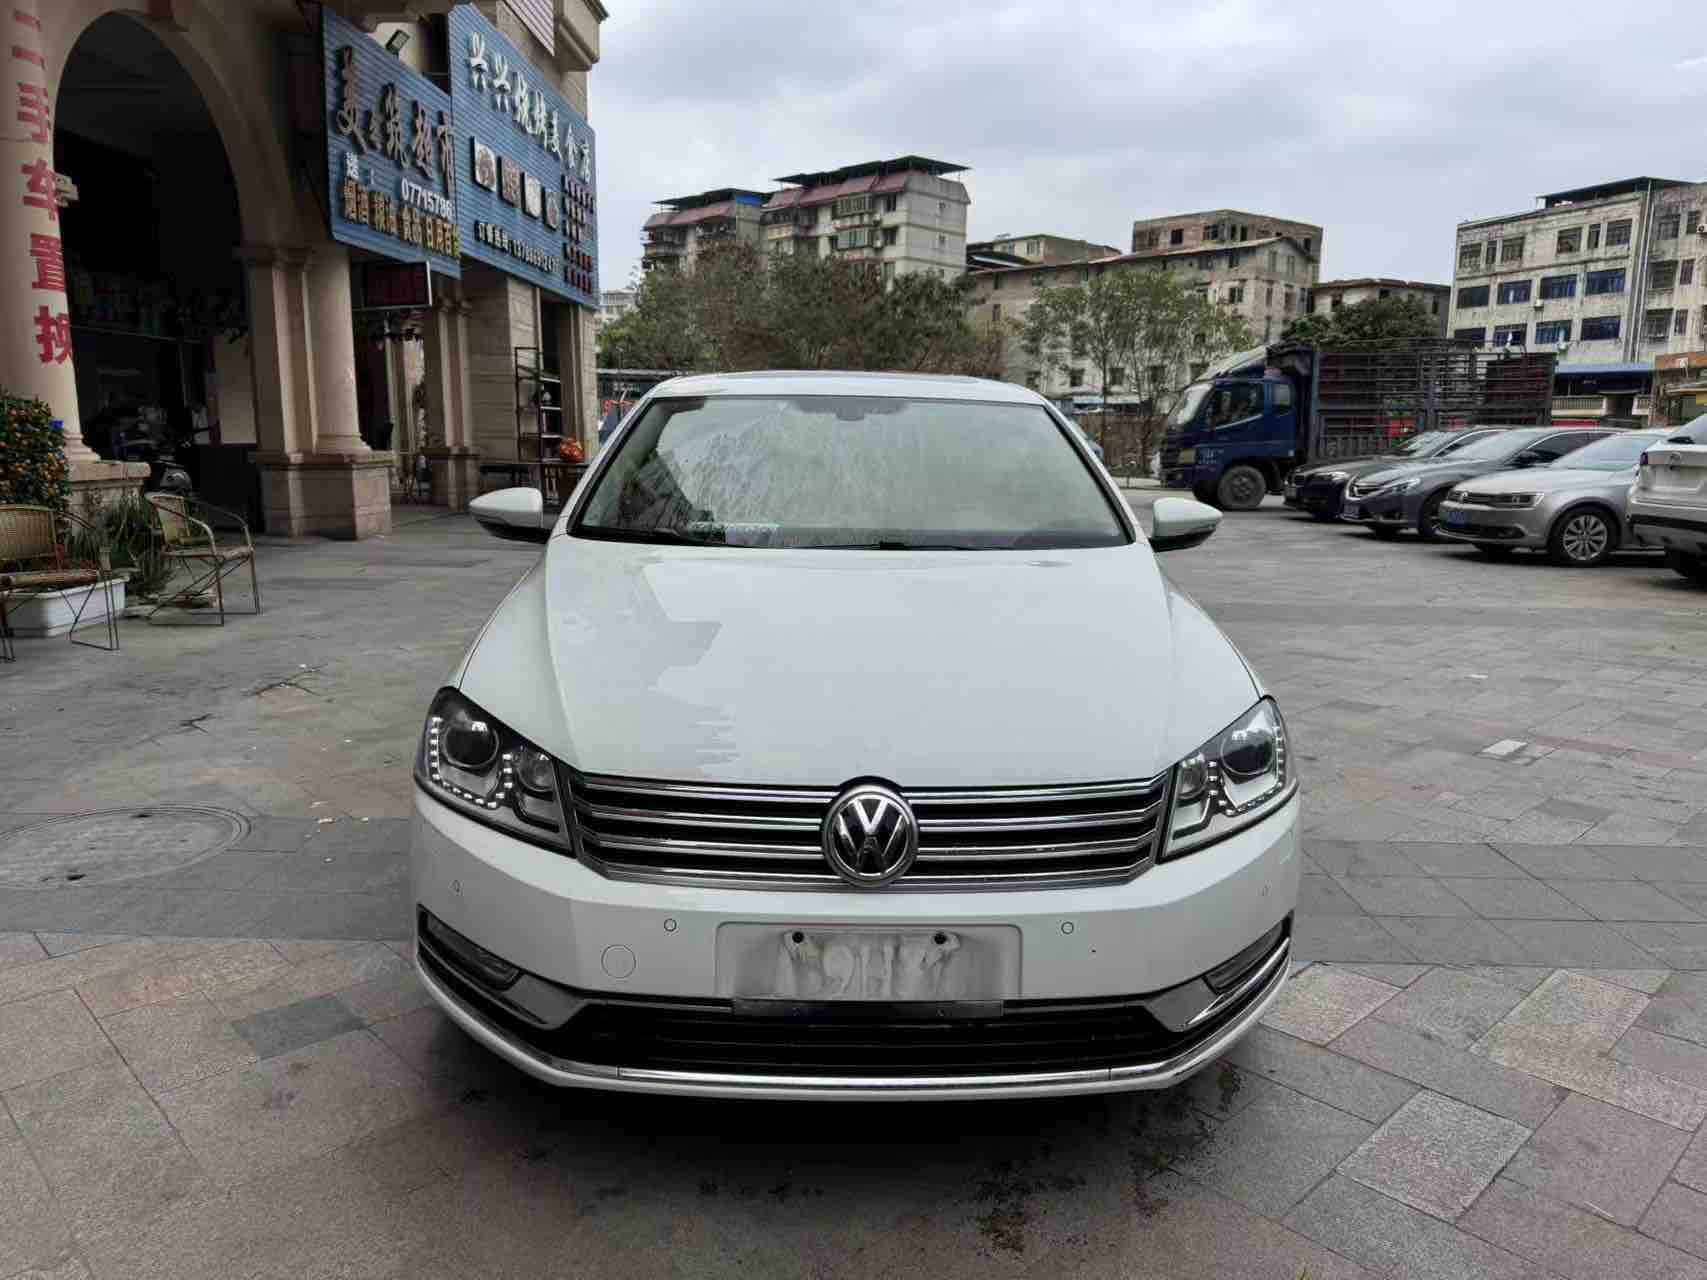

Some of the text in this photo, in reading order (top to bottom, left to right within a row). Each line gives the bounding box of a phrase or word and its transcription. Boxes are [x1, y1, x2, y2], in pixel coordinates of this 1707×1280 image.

[12, 9, 73, 366] 二手车置换
